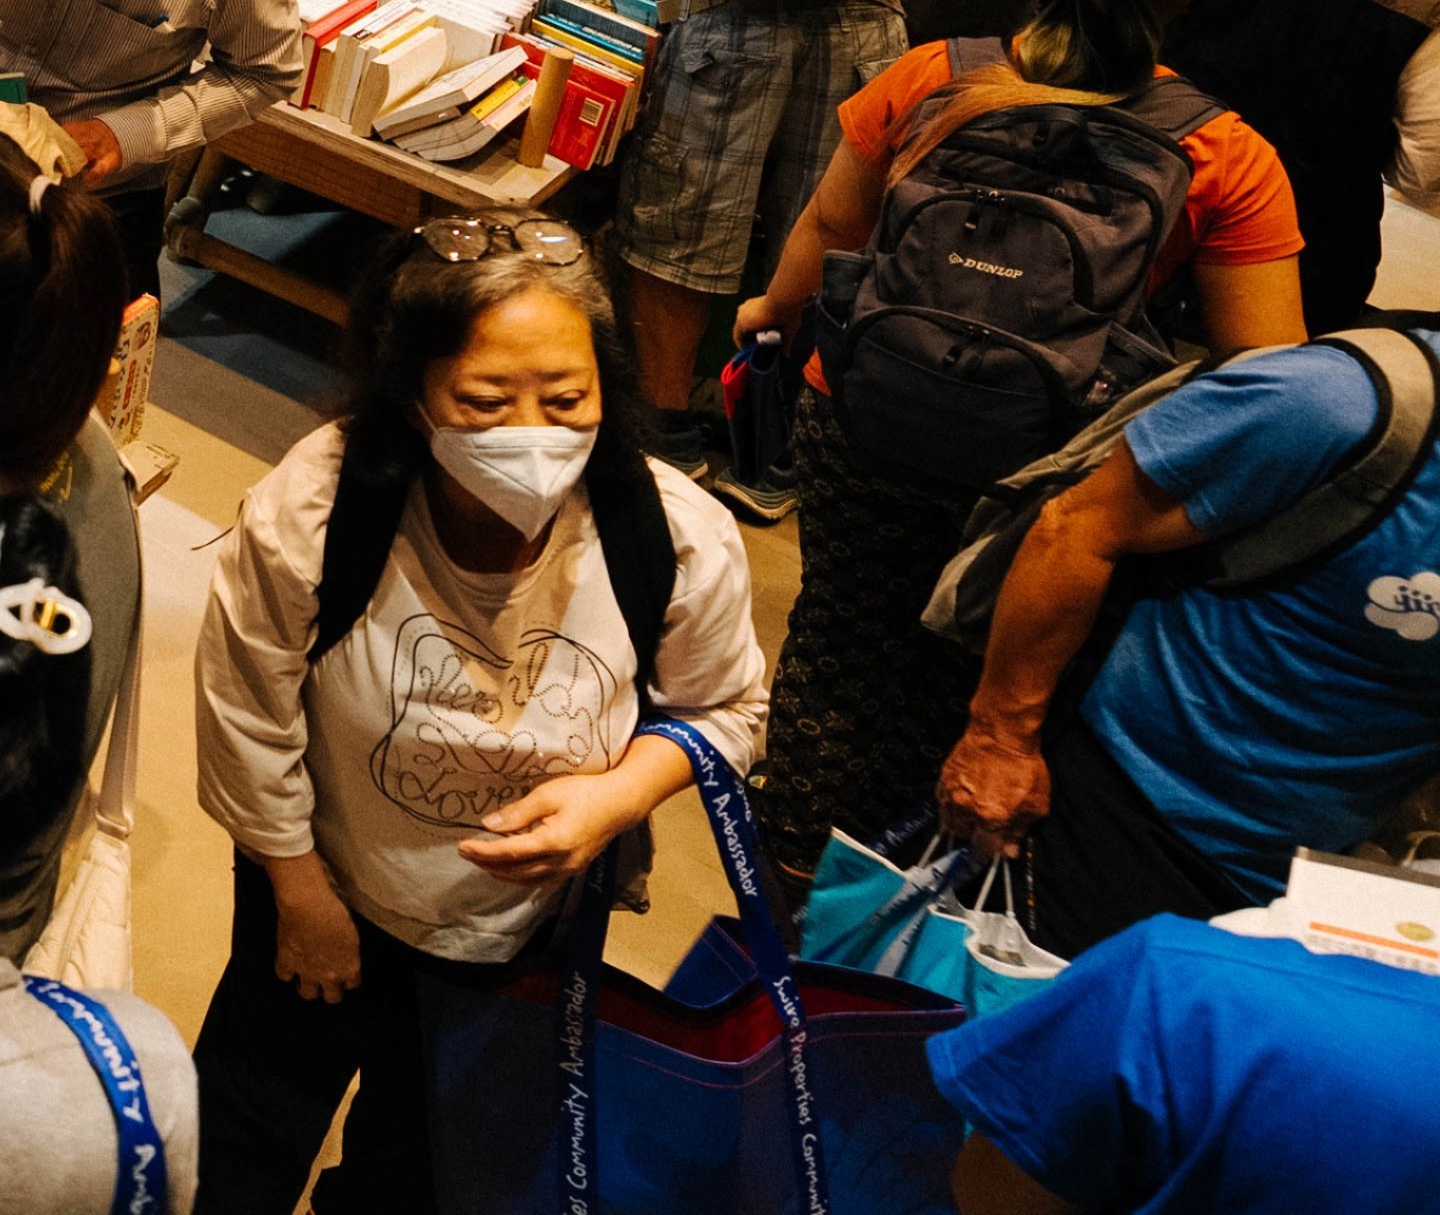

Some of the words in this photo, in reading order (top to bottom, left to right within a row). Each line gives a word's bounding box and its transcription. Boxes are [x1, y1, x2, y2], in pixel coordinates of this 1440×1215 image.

[962, 257, 1024, 279] DUNLOP
[712, 791, 758, 897] Ambassador
[558, 970, 589, 1077] Ambassador
[772, 975, 800, 1030] Swire
[785, 1031, 814, 1128] Properties
[559, 1083, 589, 1191] Community
